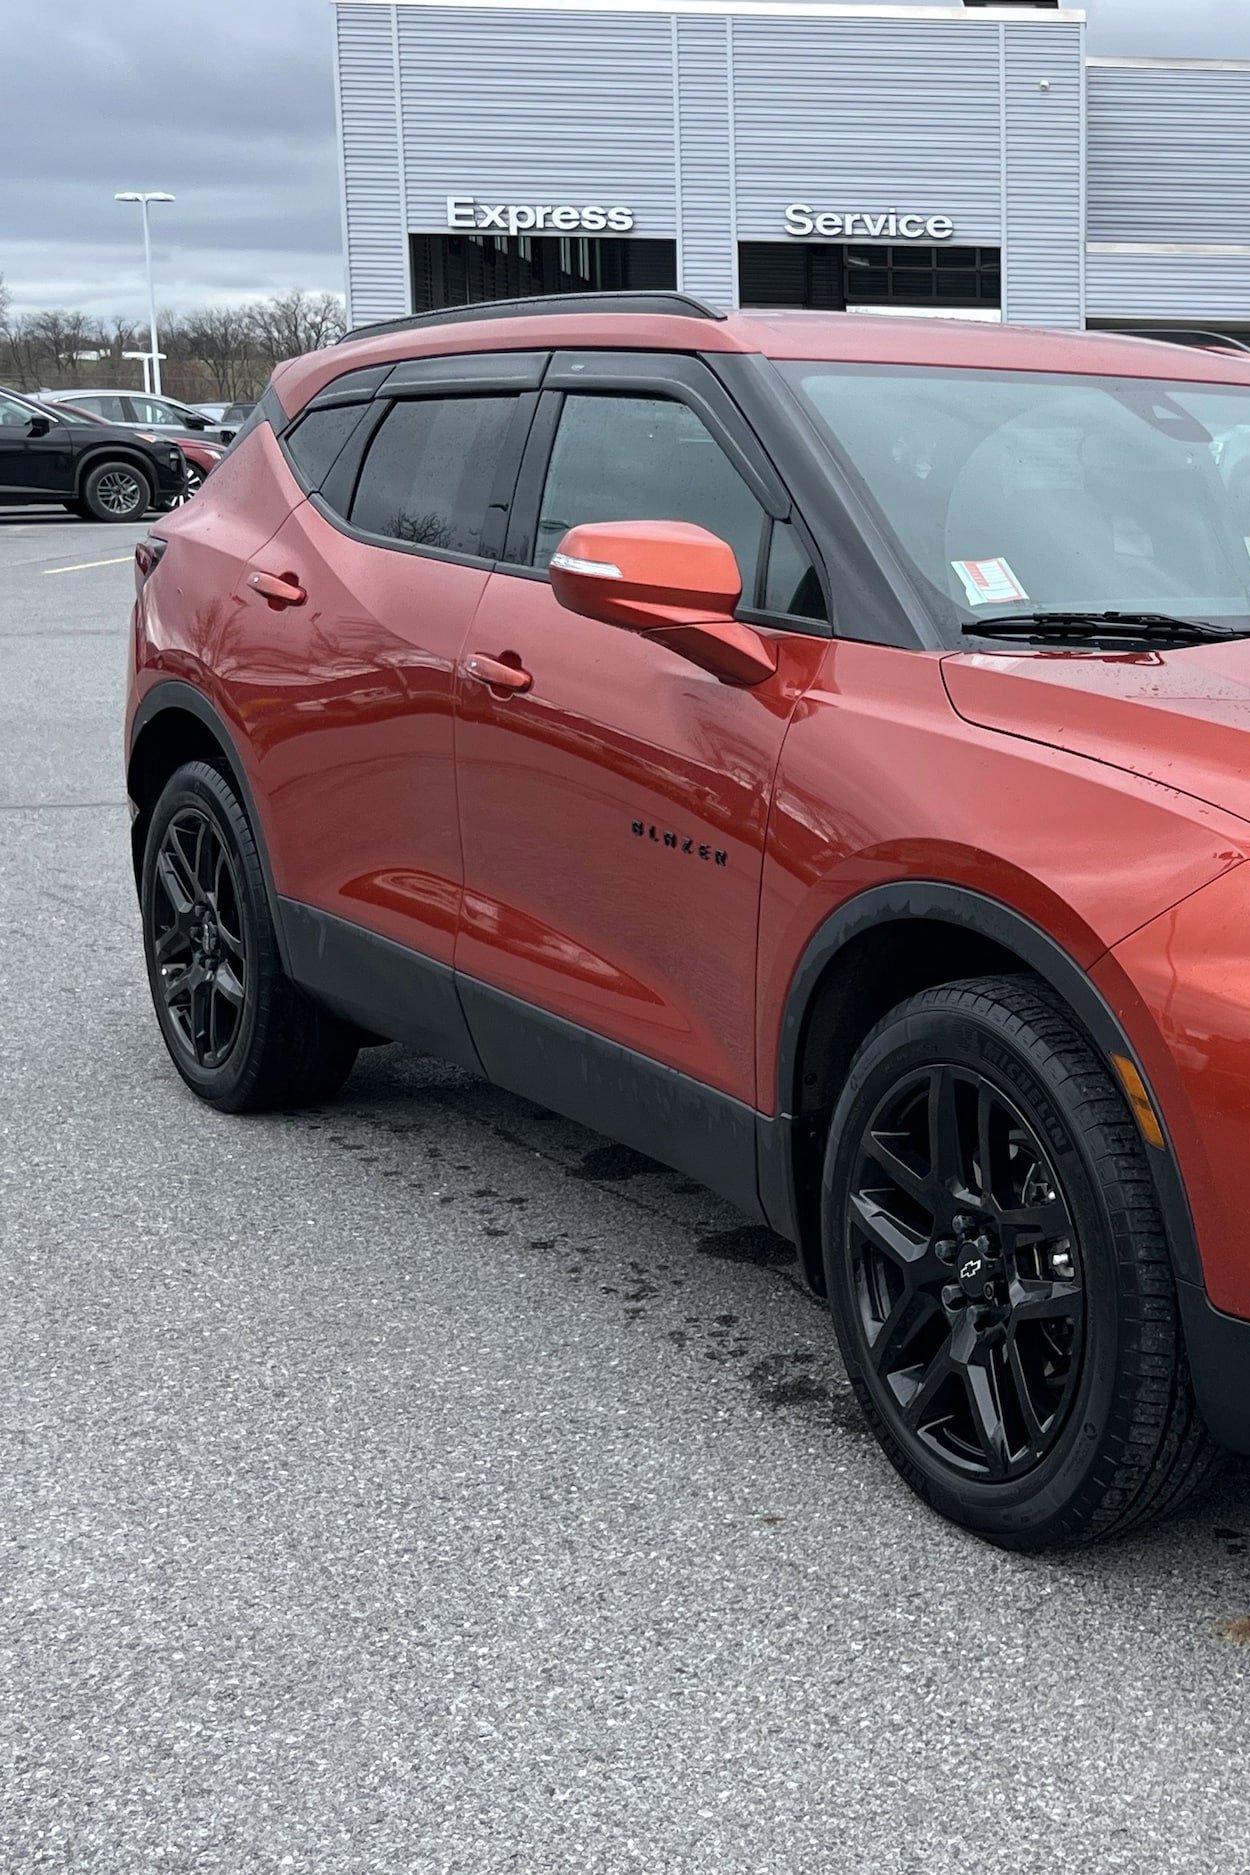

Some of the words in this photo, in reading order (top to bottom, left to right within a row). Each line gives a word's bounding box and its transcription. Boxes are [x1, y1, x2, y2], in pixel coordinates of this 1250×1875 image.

[446, 196, 634, 236] Express
[784, 204, 954, 239] Service
[631, 819, 728, 867] BLAZER
[983, 1041, 1067, 1149] MICHELIN
